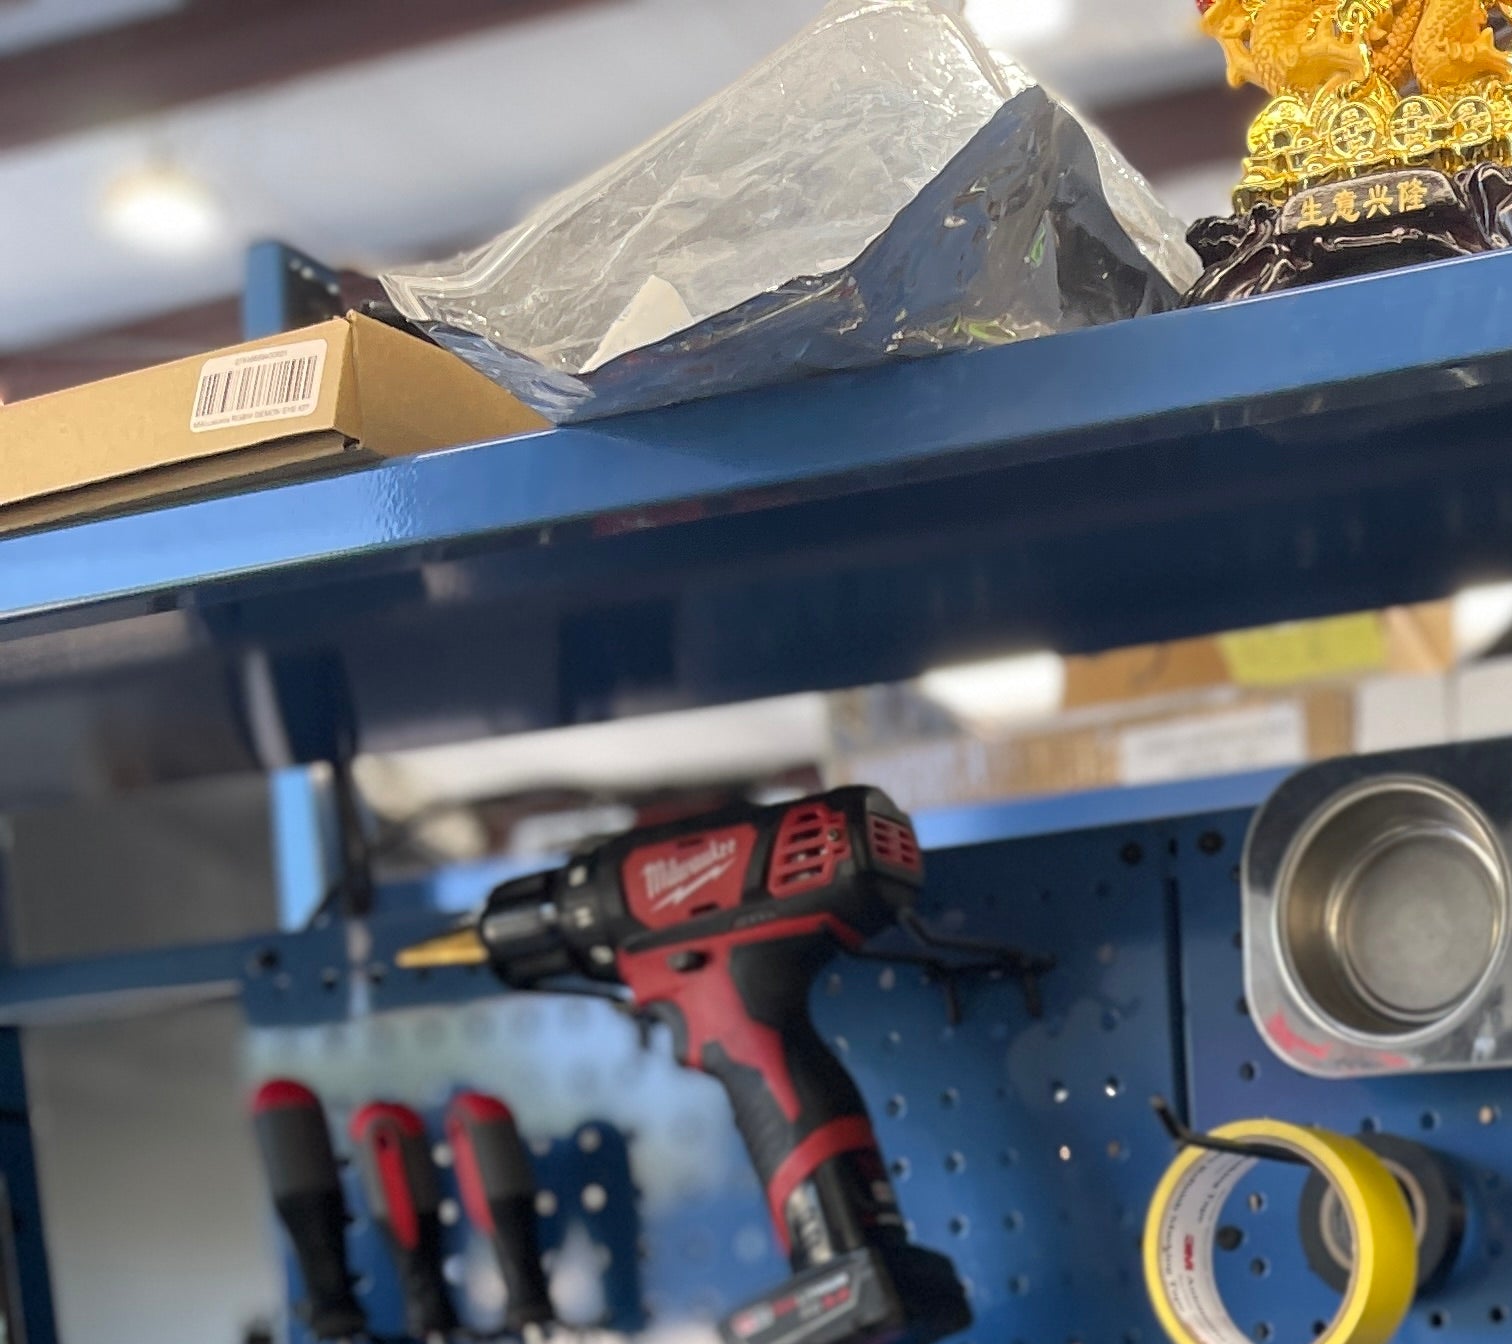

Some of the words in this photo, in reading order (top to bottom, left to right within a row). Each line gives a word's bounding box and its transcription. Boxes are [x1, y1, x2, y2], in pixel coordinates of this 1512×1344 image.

[1297, 177, 1428, 229] 生意兴隆
[642, 838, 737, 899] Milwaukee
[1183, 1233, 1196, 1272] 3M
